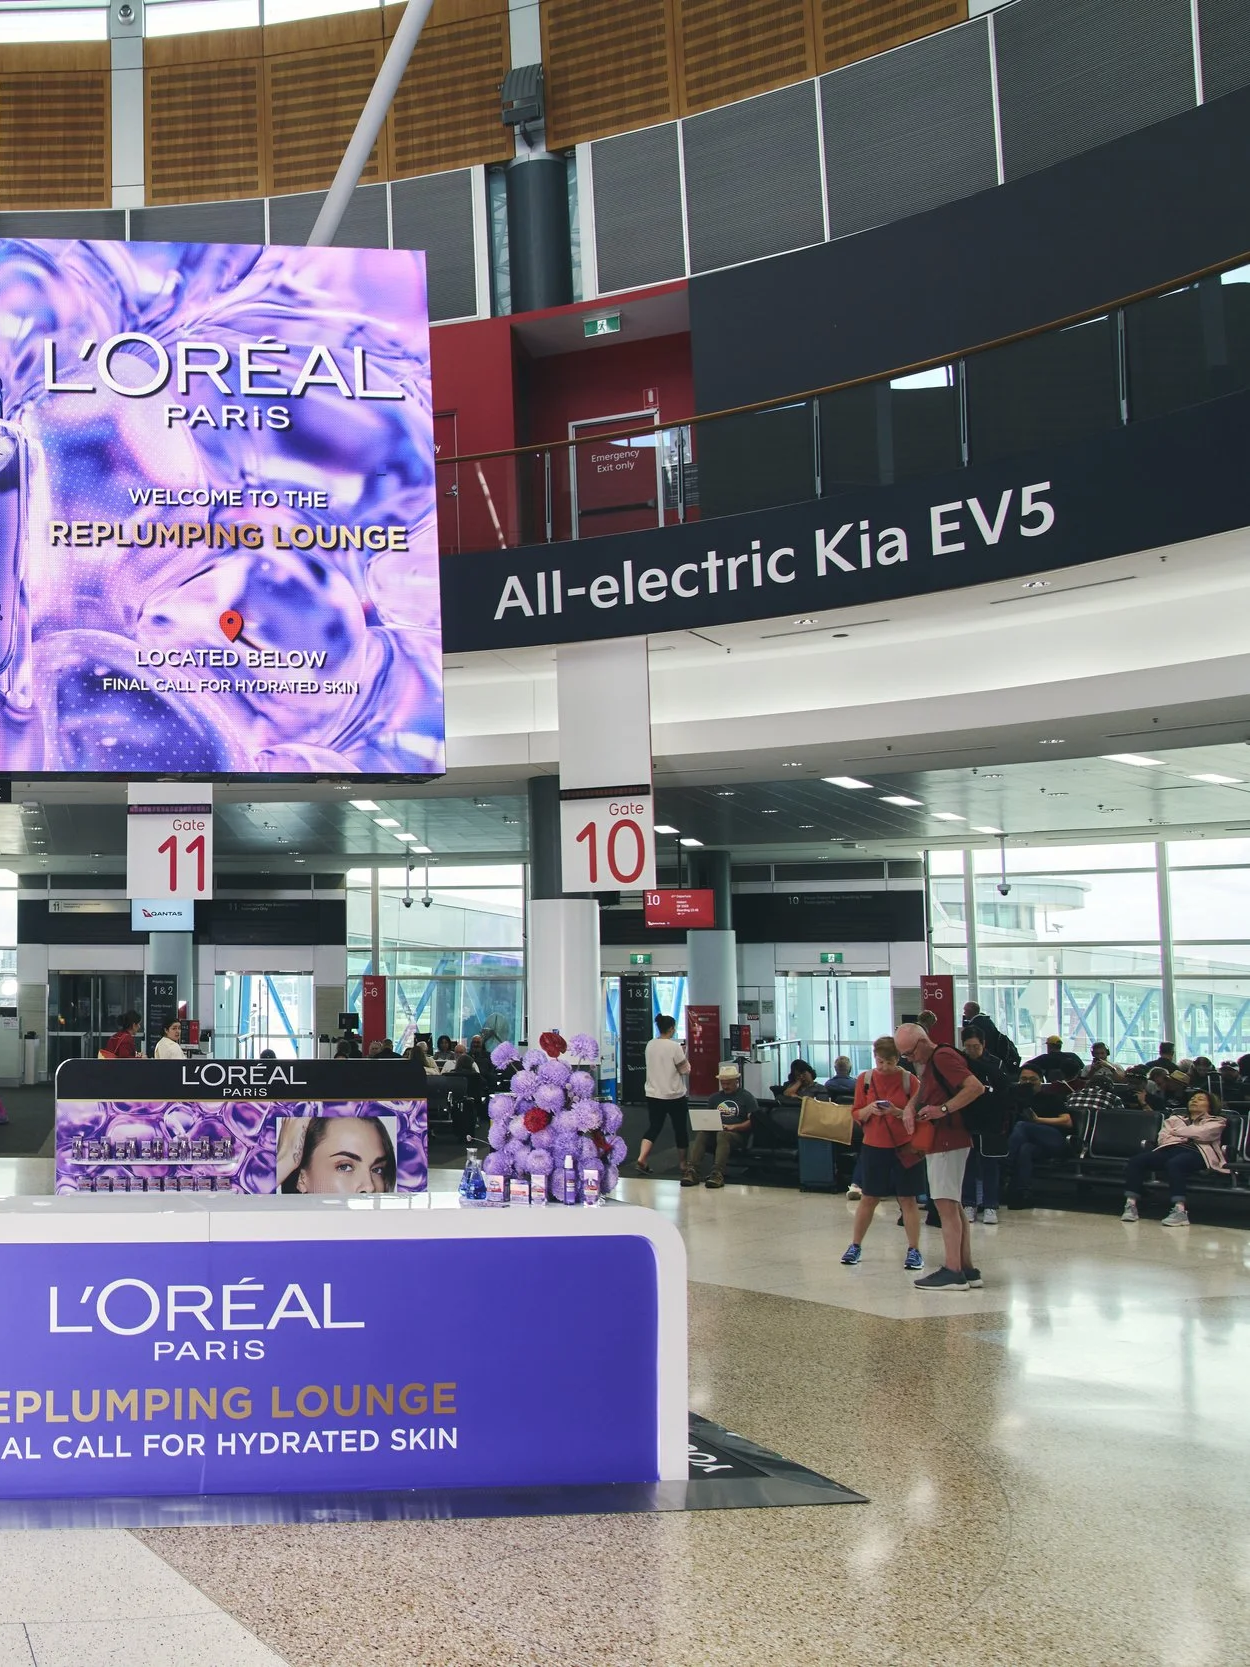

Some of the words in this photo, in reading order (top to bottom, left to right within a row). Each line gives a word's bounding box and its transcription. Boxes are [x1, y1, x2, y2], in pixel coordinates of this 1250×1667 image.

[44, 331, 406, 402] L'ORÉAL
[591, 449, 640, 463] Emergency
[597, 464, 613, 473] Exit
[615, 461, 635, 471] only
[128, 488, 243, 507] WELCOME
[249, 489, 278, 508] TO
[284, 491, 328, 508] THE
[49, 521, 263, 549] REPLUMPING
[272, 525, 409, 551] LOUNGE
[493, 539, 796, 621] All-electric
[815, 519, 908, 577] Kia
[929, 481, 1056, 557] EV5
[135, 650, 239, 668] LOCATED
[246, 650, 327, 668] BELOW
[102, 678, 150, 692] FINAL
[155, 679, 196, 693] CALL
[200, 679, 232, 693] FOR
[235, 679, 319, 694] HYDRATED
[323, 680, 359, 694] SKIN
[609, 802, 644, 816] Gate
[172, 819, 205, 831] Gate
[576, 819, 645, 884] 10
[158, 835, 205, 892] 11
[646, 894, 660, 906] 10
[787, 896, 799, 904] 10
[182, 1063, 307, 1087] L'ORÉAL
[50, 1277, 366, 1337] L'ORÉAL
[272, 1382, 458, 1419] LOUNGE
[52, 1435, 131, 1459] CALL
[143, 1433, 205, 1457] FOR
[217, 1429, 379, 1456] HYDRATED
[390, 1427, 458, 1450] SKIN
